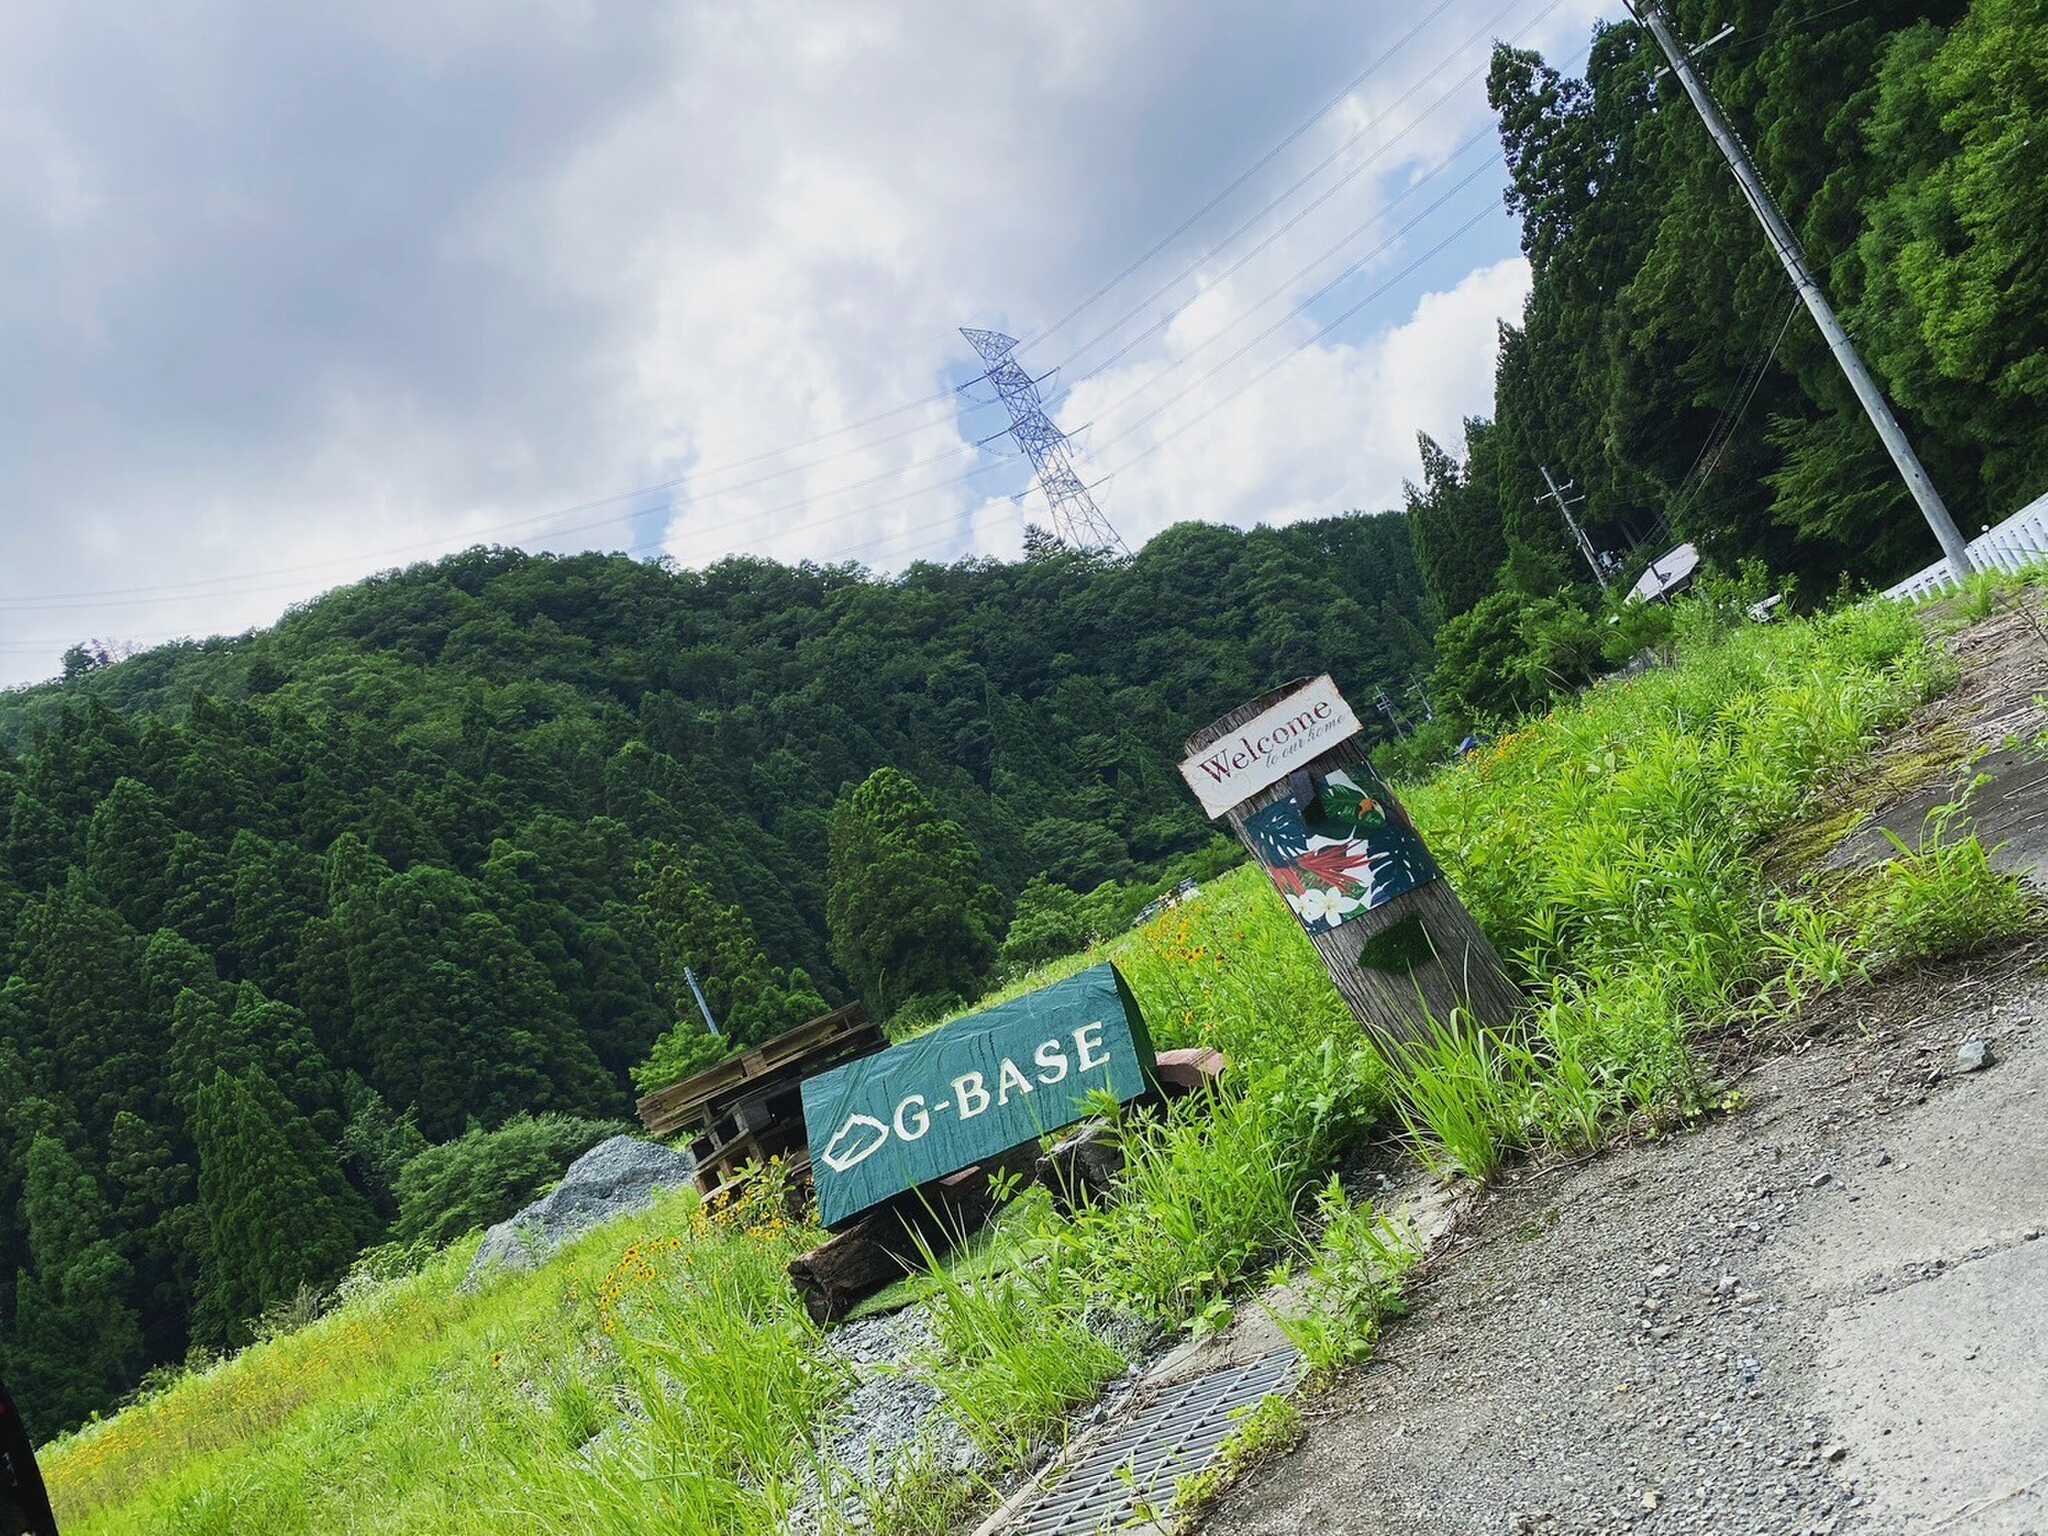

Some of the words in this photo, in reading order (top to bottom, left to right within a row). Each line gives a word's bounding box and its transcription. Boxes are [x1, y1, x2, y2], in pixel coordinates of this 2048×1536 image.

[1199, 702, 1332, 784] Welcome
[1265, 753, 1279, 768] to
[1282, 739, 1303, 758] our
[1307, 715, 1345, 742] home
[894, 1021, 1110, 1142] G-BASE
